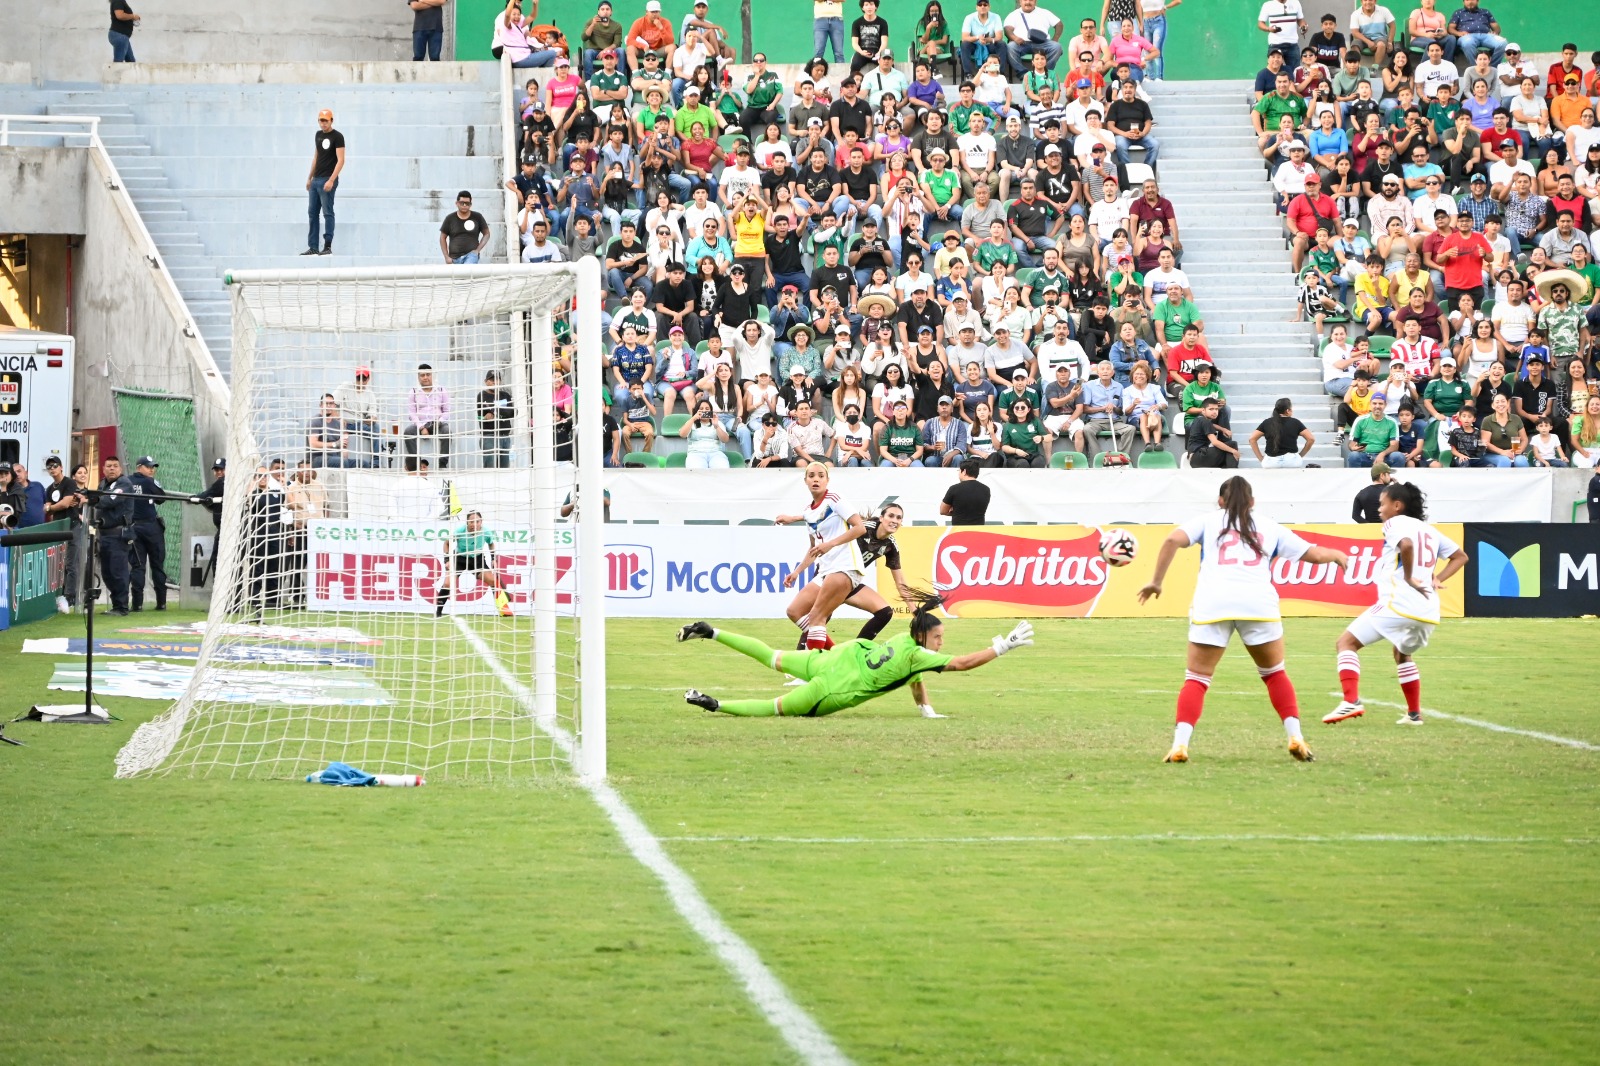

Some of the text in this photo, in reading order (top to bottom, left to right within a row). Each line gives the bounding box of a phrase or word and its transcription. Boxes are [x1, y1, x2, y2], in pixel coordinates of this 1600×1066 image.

[315, 527, 358, 541] CON
[362, 529, 418, 542] TODA
[1218, 528, 1264, 566] 23
[1417, 532, 1435, 568] 15
[932, 545, 1108, 592] Sabritas
[1558, 552, 1599, 591] M
